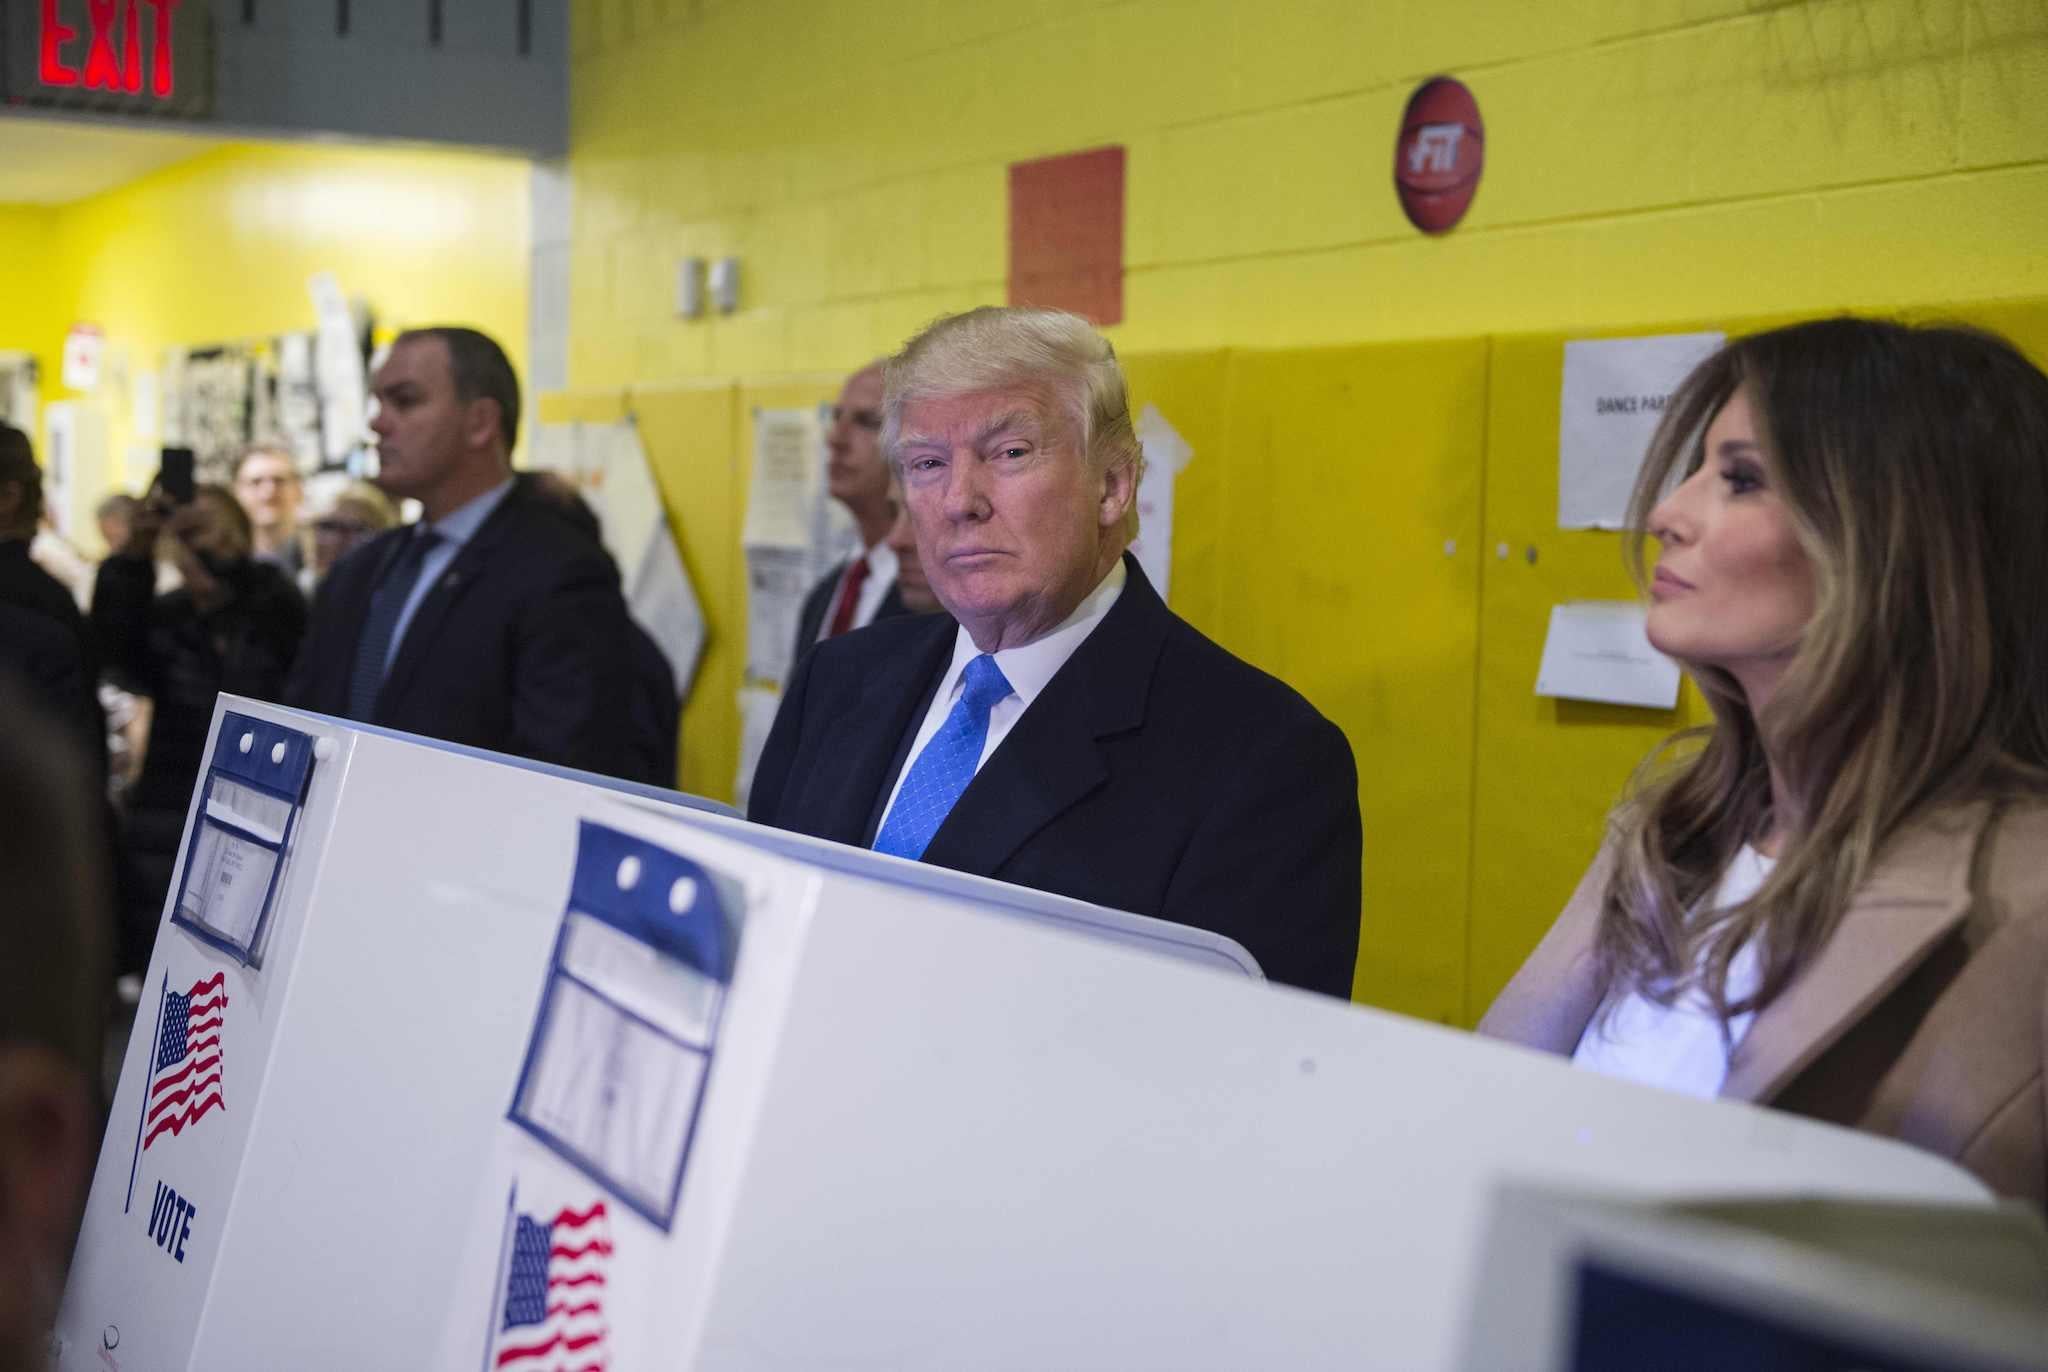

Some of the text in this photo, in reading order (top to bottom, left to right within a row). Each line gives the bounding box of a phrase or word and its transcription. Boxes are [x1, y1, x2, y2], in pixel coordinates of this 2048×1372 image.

[39, 0, 183, 97] EXIT
[1597, 396, 1637, 414] DANCE
[148, 1179, 196, 1265] VOTE
